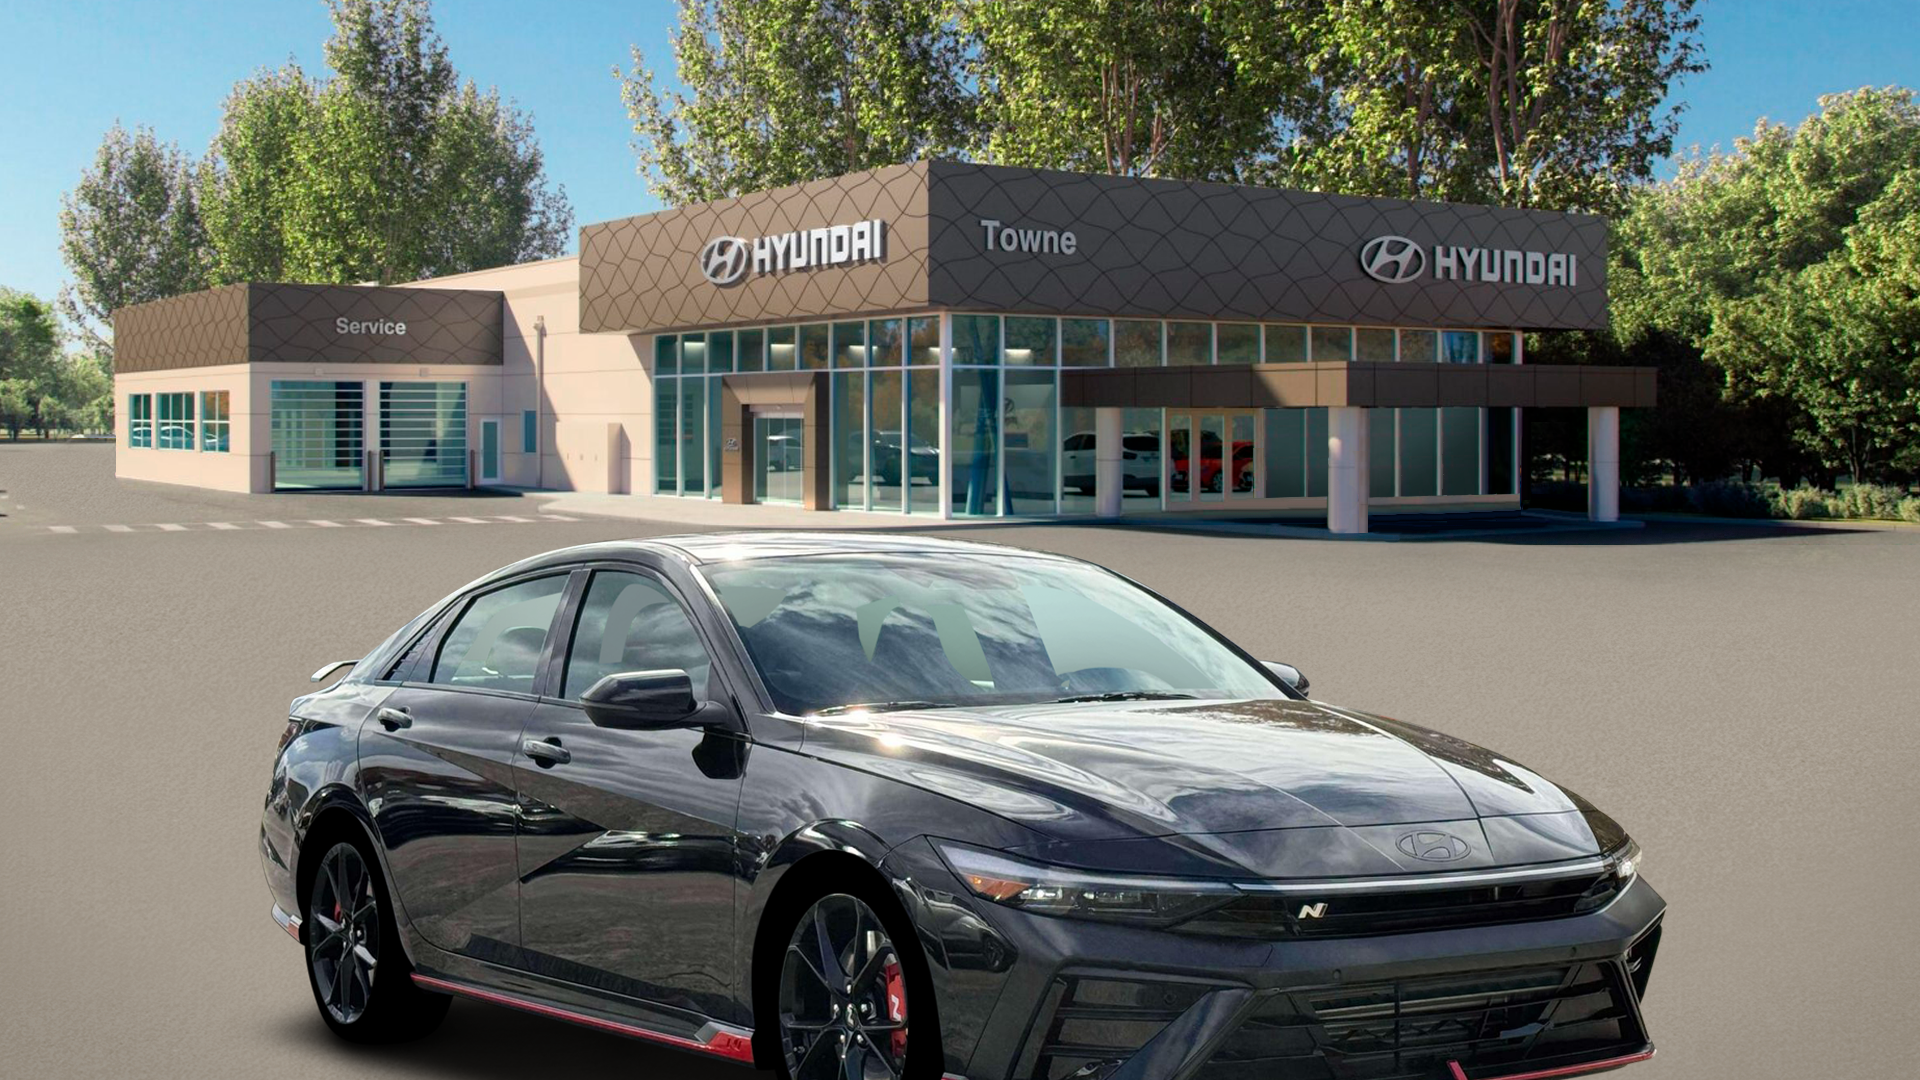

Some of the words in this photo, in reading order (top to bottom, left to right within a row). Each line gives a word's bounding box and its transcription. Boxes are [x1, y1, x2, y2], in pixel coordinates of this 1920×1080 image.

[753, 219, 882, 273] HYUNDAI
[980, 219, 1077, 255] Towne
[1434, 246, 1577, 287] HYUNDAI
[335, 317, 407, 335] Service
[1298, 902, 1328, 919] N
